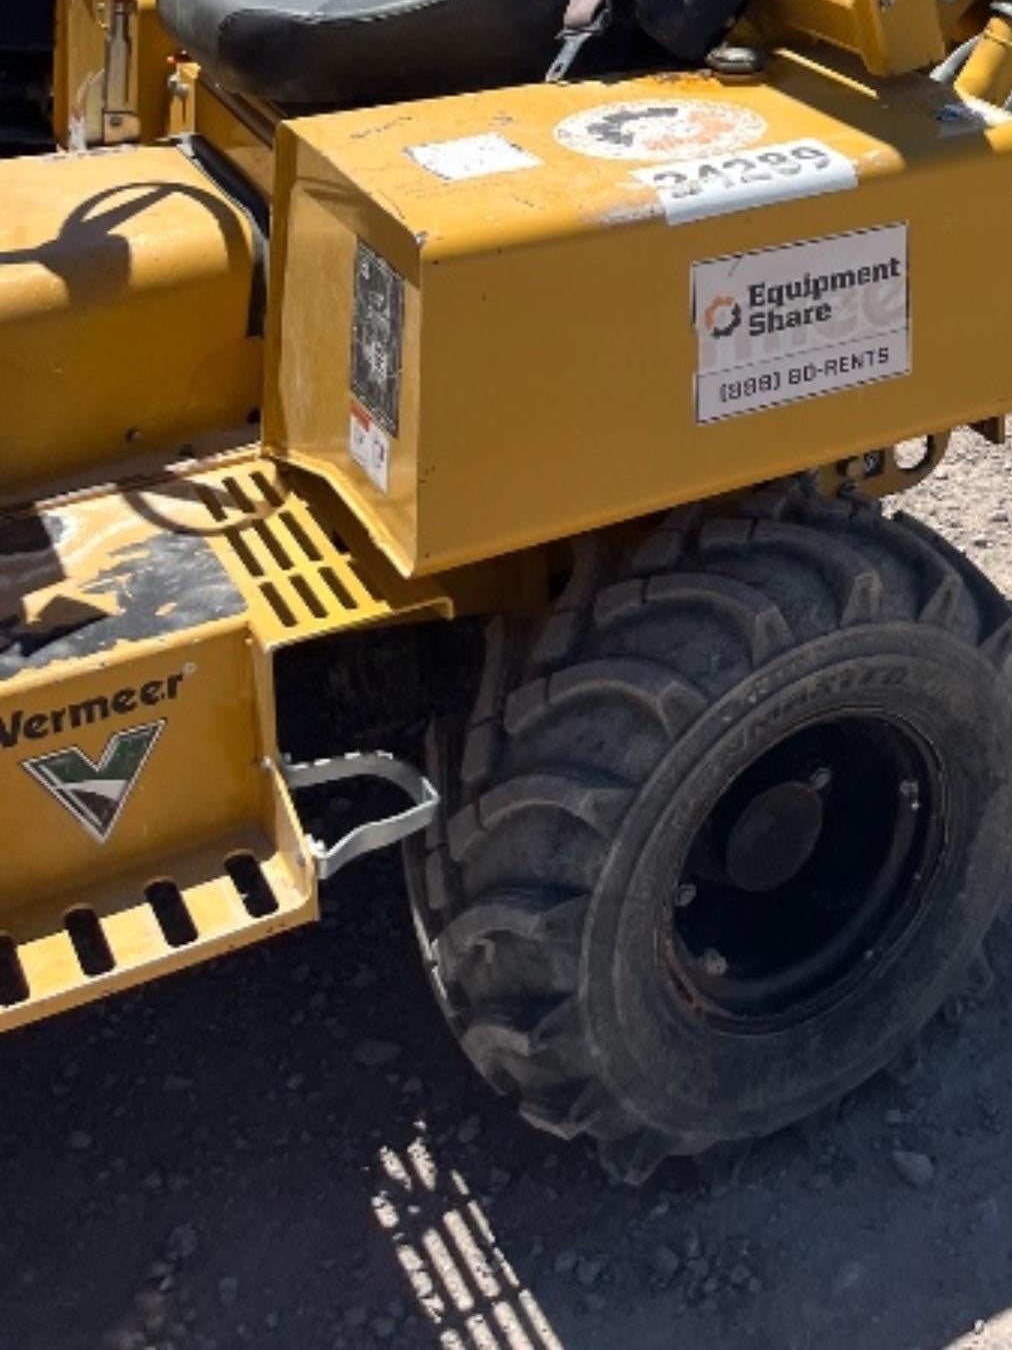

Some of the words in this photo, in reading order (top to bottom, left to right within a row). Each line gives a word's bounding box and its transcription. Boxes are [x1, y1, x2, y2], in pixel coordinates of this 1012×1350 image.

[748, 257, 901, 306] Equipment
[749, 303, 832, 337] Share
[0, 671, 183, 747] Vermeer
